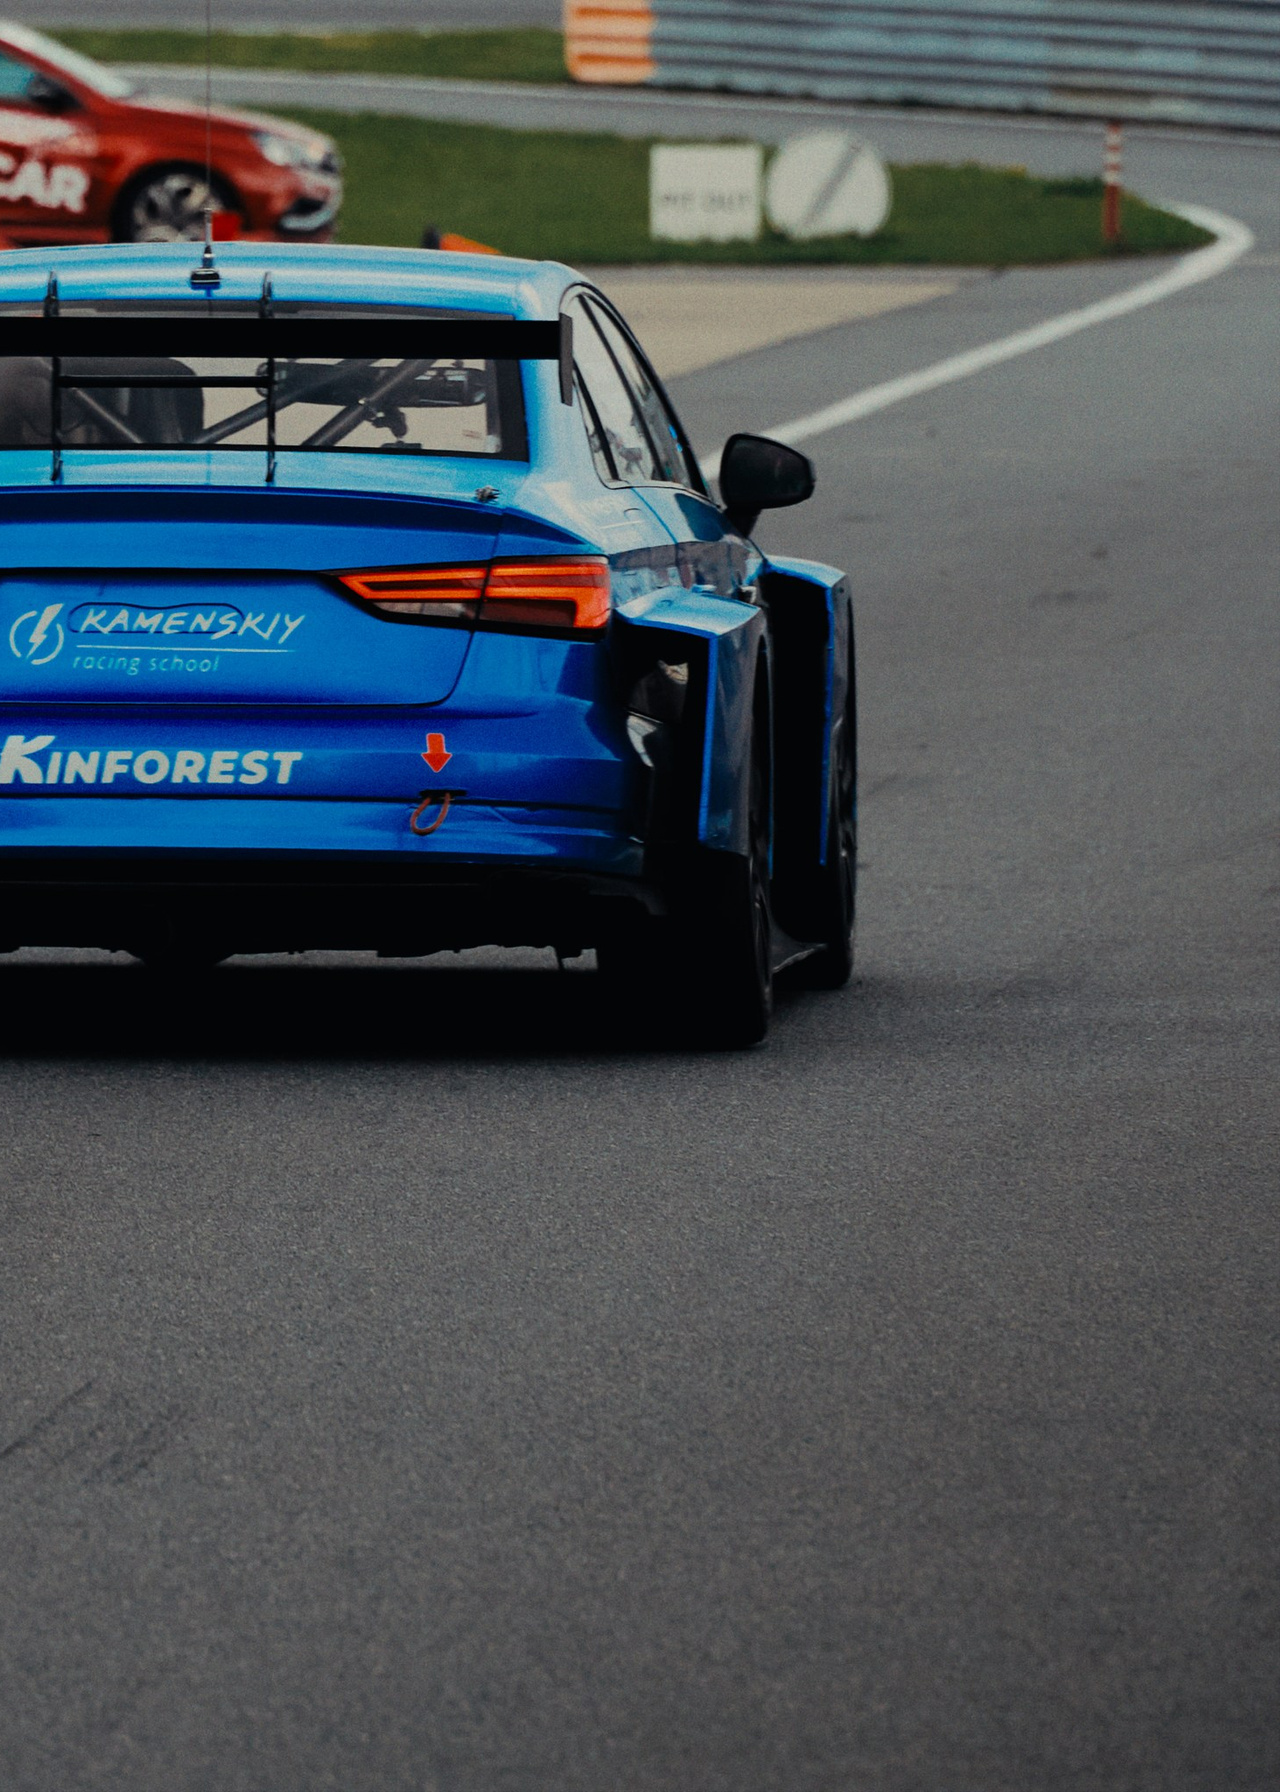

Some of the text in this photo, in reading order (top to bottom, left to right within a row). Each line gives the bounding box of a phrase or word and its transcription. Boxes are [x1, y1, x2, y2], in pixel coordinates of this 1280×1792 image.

[80, 608, 306, 644] KAMENSKIY
[72, 654, 221, 676] racing school
